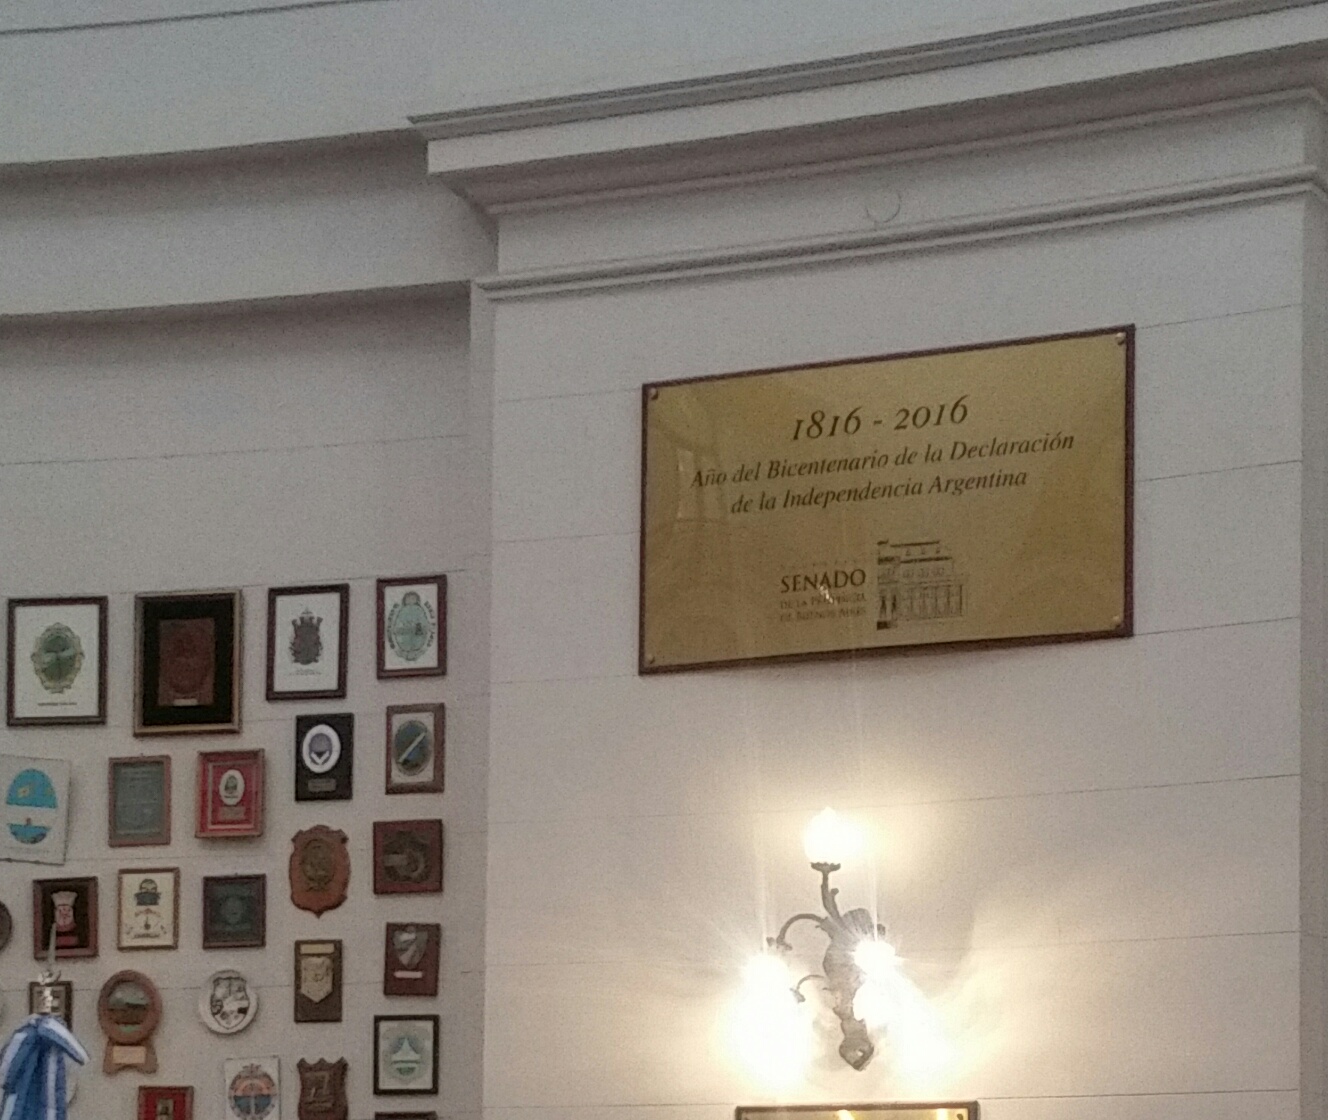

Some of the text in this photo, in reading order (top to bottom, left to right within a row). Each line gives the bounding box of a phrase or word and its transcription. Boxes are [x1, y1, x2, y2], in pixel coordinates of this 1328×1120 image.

[792, 406, 863, 441] 1816
[894, 394, 969, 431] 2016
[690, 431, 1074, 489] Año del Bicentenario de la Declaración
[730, 469, 1028, 514] de la Independencia Argentina
[780, 568, 866, 594] SENADO
